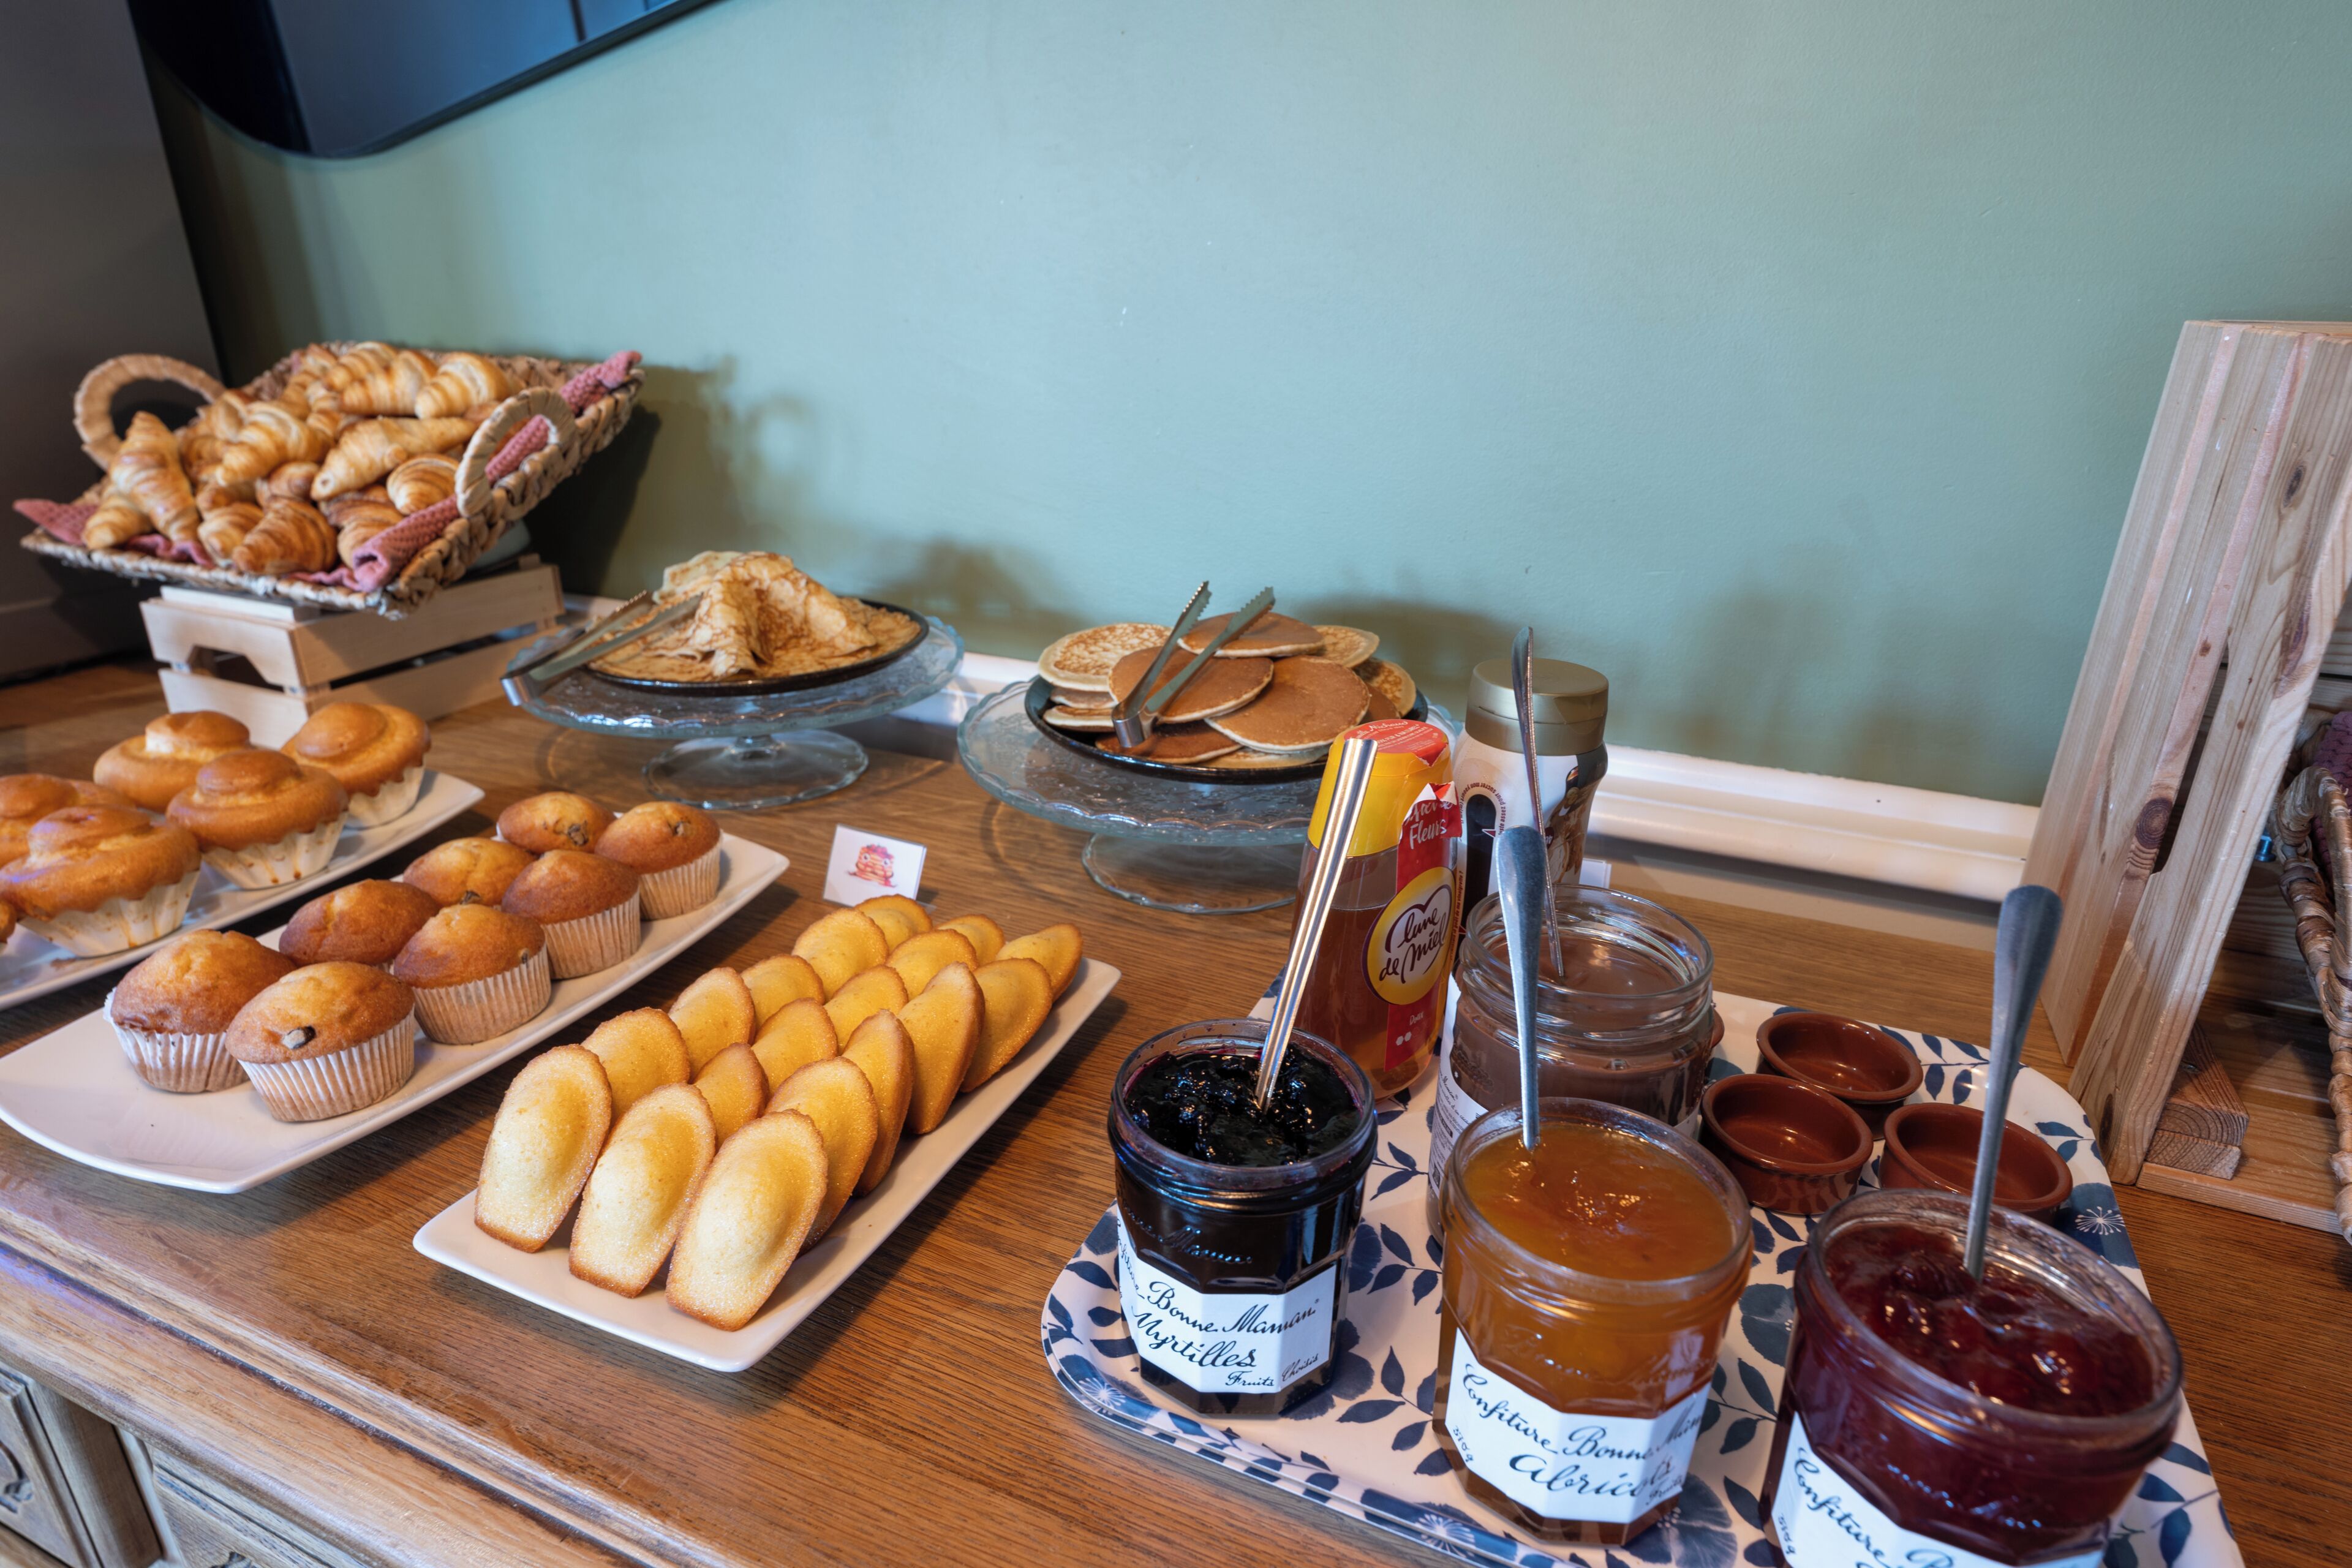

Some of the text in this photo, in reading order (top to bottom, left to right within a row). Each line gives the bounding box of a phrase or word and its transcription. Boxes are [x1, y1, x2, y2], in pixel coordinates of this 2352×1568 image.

[1461, 784, 1471, 802] yaourt
[1480, 782, 1497, 794] sucrer
[1495, 793, 1506, 805] pour
[1409, 819, 1447, 850] Fleurs
[1379, 958, 1400, 981] de
[1147, 1280, 1218, 1333] Bonne
[1131, 1305, 1257, 1368] Myrtilles
[1225, 1354, 1319, 1387] Fruits Choisis
[1463, 1363, 1559, 1455] Confiture
[1562, 1425, 1653, 1461] Bonne
[1794, 1447, 1890, 1568] Confiture
